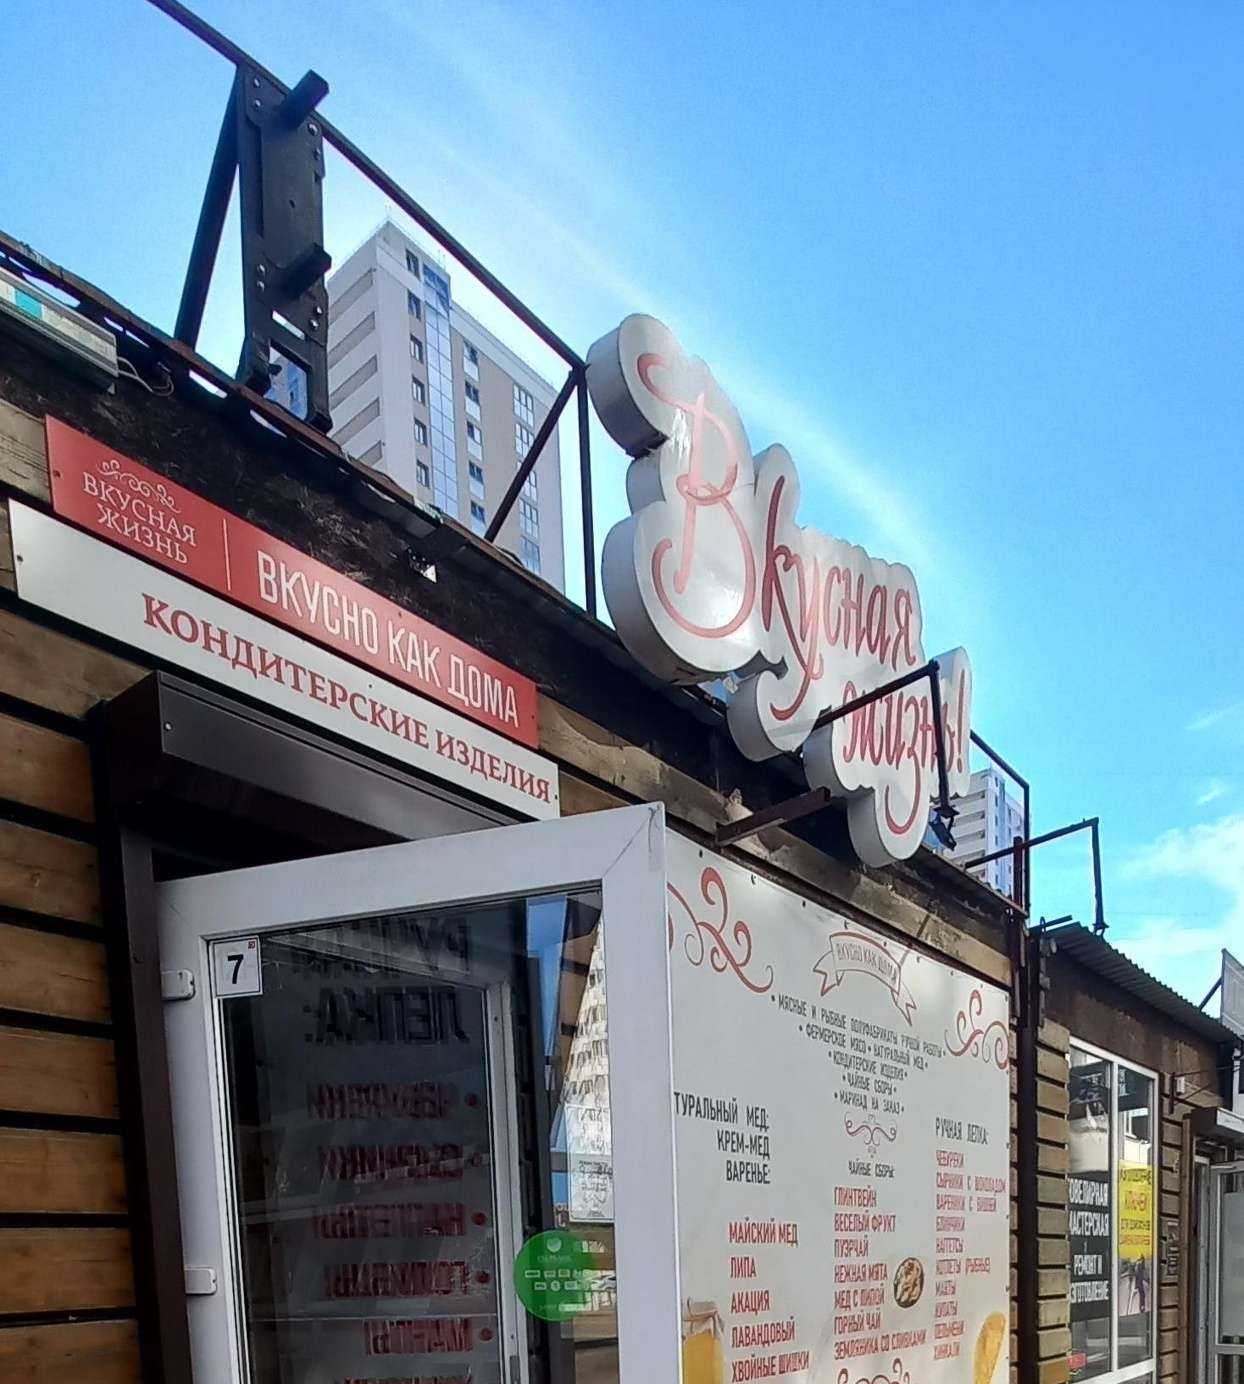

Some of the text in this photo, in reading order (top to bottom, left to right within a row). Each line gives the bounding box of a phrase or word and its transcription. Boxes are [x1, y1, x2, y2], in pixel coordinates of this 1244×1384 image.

[83, 471, 196, 547] ВКУСНАЯ
[97, 508, 189, 565] ЖИЗНЬ
[637, 352, 917, 721] Вкусная
[257, 549, 520, 728] ВКУСНО КАК ДОМА
[141, 593, 550, 803] КОНДИТЕРСКИЕ ИЗДЕЛИЯ
[228, 954, 244, 984] 7
[778, 994, 807, 1017] МЯСНЫЕ
[821, 1007, 846, 1029] РЫБНЫЕ
[673, 1091, 770, 1132] ТУРАЛЬНЫЙ МЕД:
[717, 1129, 770, 1160] КРЕМ-МЕД
[834, 1185, 877, 1208] ГЛИНТВЕЙН
[729, 1216, 798, 1248] МАЙСКИЙ МЕД
[834, 1209, 896, 1233] ВЕСЕЛЫЙ ФРУКТ
[730, 1256, 757, 1279] ЛИПА
[834, 1263, 888, 1283] НЕЖНАЯ МЯТА
[731, 1290, 770, 1316] АКАЦИЯ
[834, 1290, 851, 1311] МЕД
[853, 1289, 858, 1307] С
[732, 1315, 795, 1348] ЛАВАНДОВЫЙ
[834, 1307, 881, 1335] ГОРНЫЙ ЧАЙ
[732, 1350, 810, 1383] ХВОЙНЫЕ ШИШКИ
